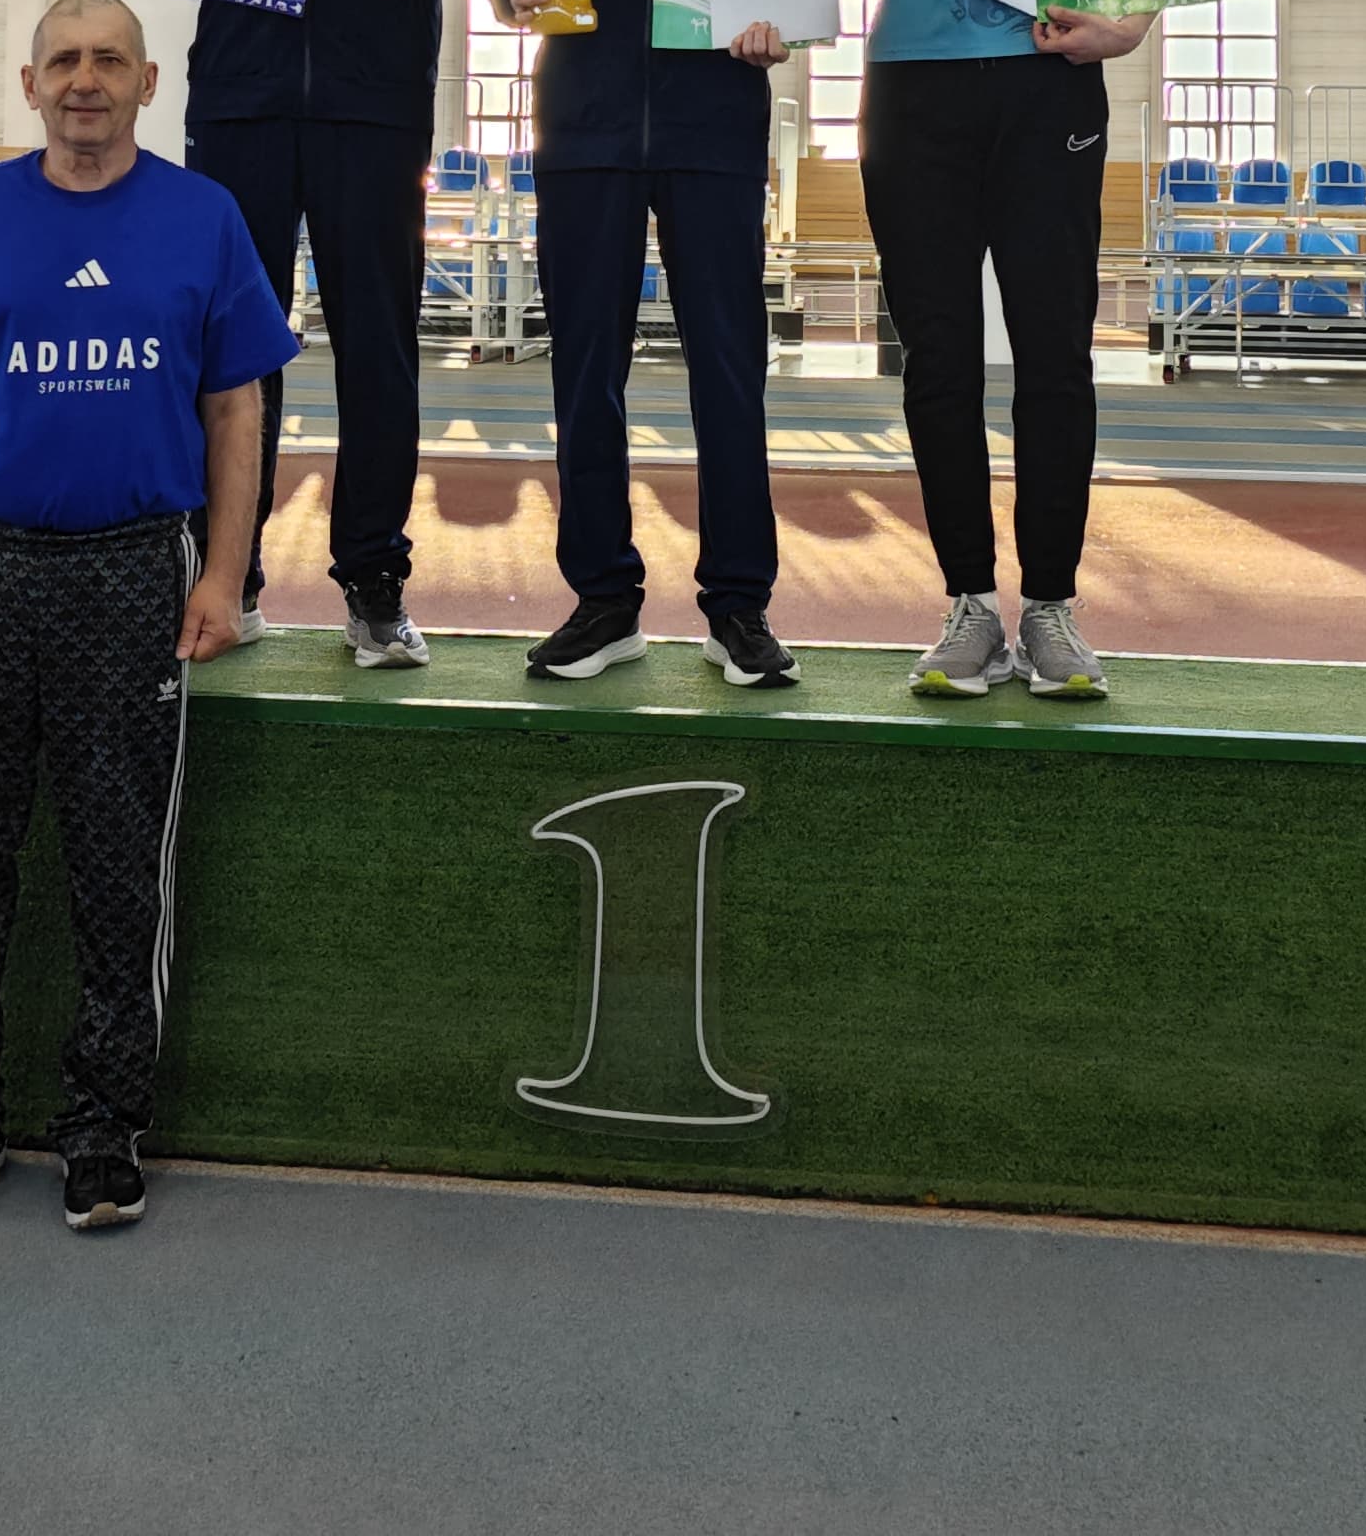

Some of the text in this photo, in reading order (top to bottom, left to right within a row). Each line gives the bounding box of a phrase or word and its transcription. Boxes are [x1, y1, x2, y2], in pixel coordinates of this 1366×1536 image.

[7, 337, 161, 373] ADIDAS
[38, 378, 131, 394] SPORTSWEAR
[516, 780, 770, 1124] 1
